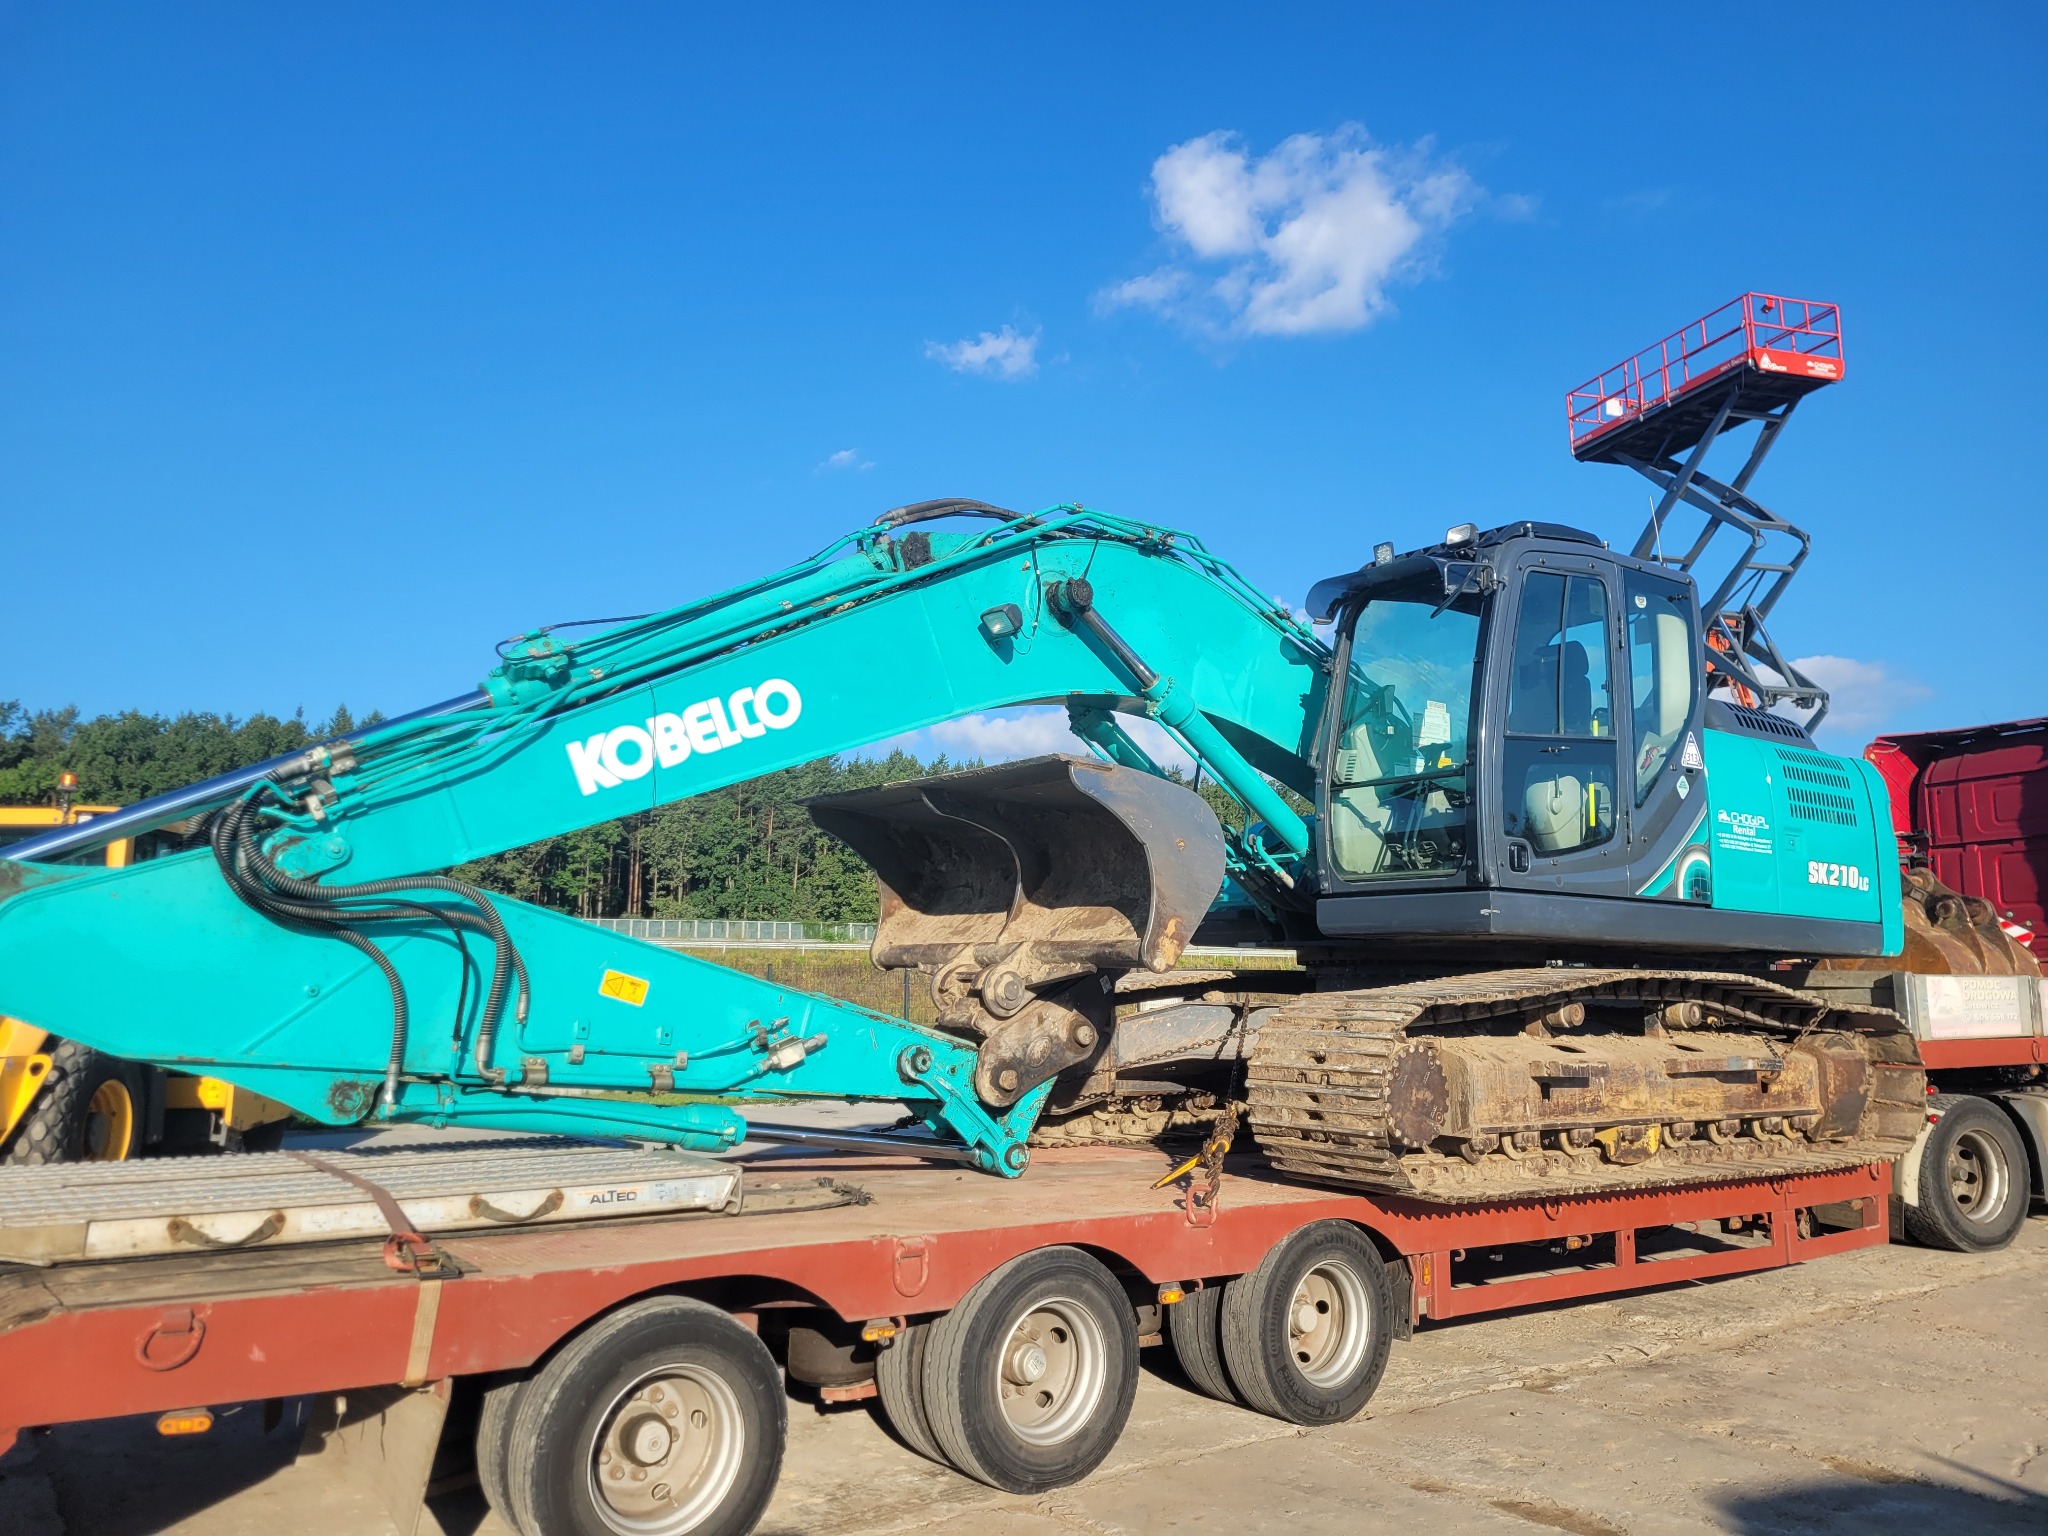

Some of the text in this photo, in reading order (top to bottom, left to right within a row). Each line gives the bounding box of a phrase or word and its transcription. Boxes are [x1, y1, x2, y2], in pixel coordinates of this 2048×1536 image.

[565, 678, 803, 796] KOBELCO
[1686, 753, 1698, 763] 313
[1732, 824, 1756, 836] Rental
[1962, 979, 2001, 990] POMOC
[1962, 990, 2018, 1001] DROGOWA
